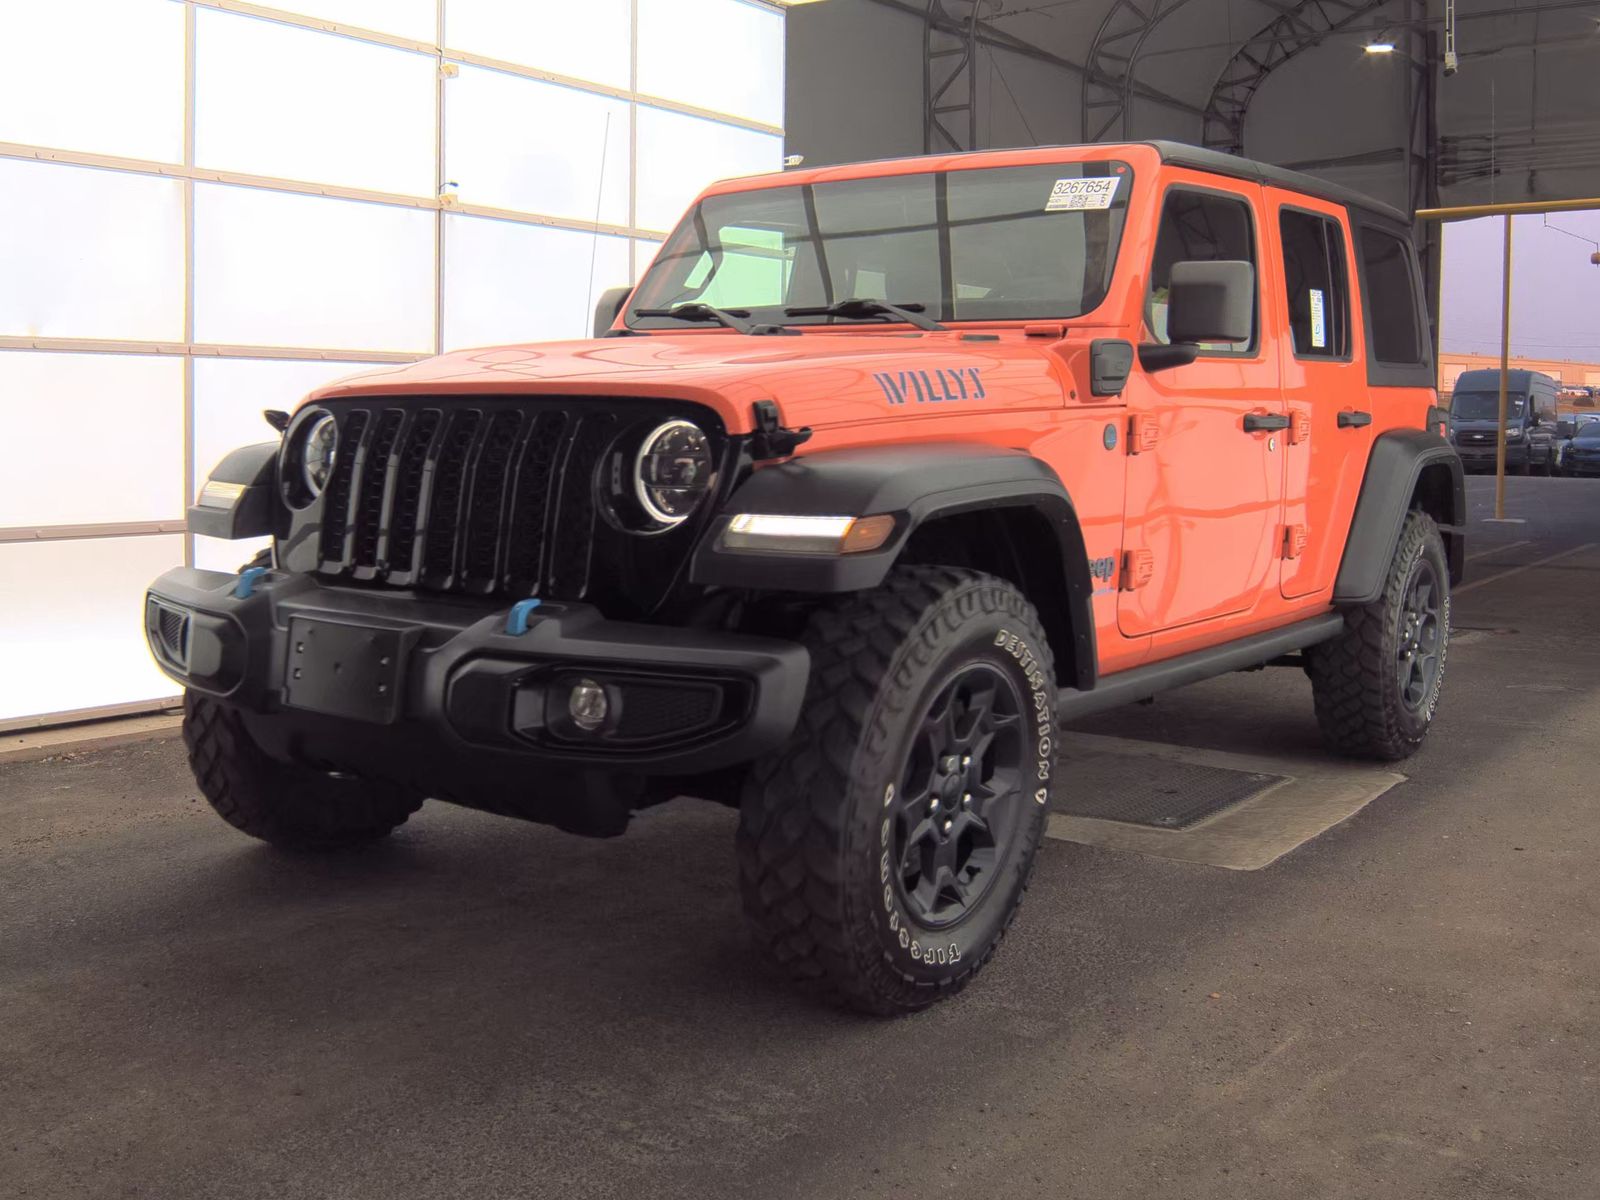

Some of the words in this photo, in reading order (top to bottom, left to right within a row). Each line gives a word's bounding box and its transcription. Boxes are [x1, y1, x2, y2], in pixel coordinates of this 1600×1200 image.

[1053, 180, 1111, 195] 3267654
[872, 368, 986, 404] WILLYS
[1088, 556, 1115, 582] eep
[994, 629, 1051, 781] DESTINATION
